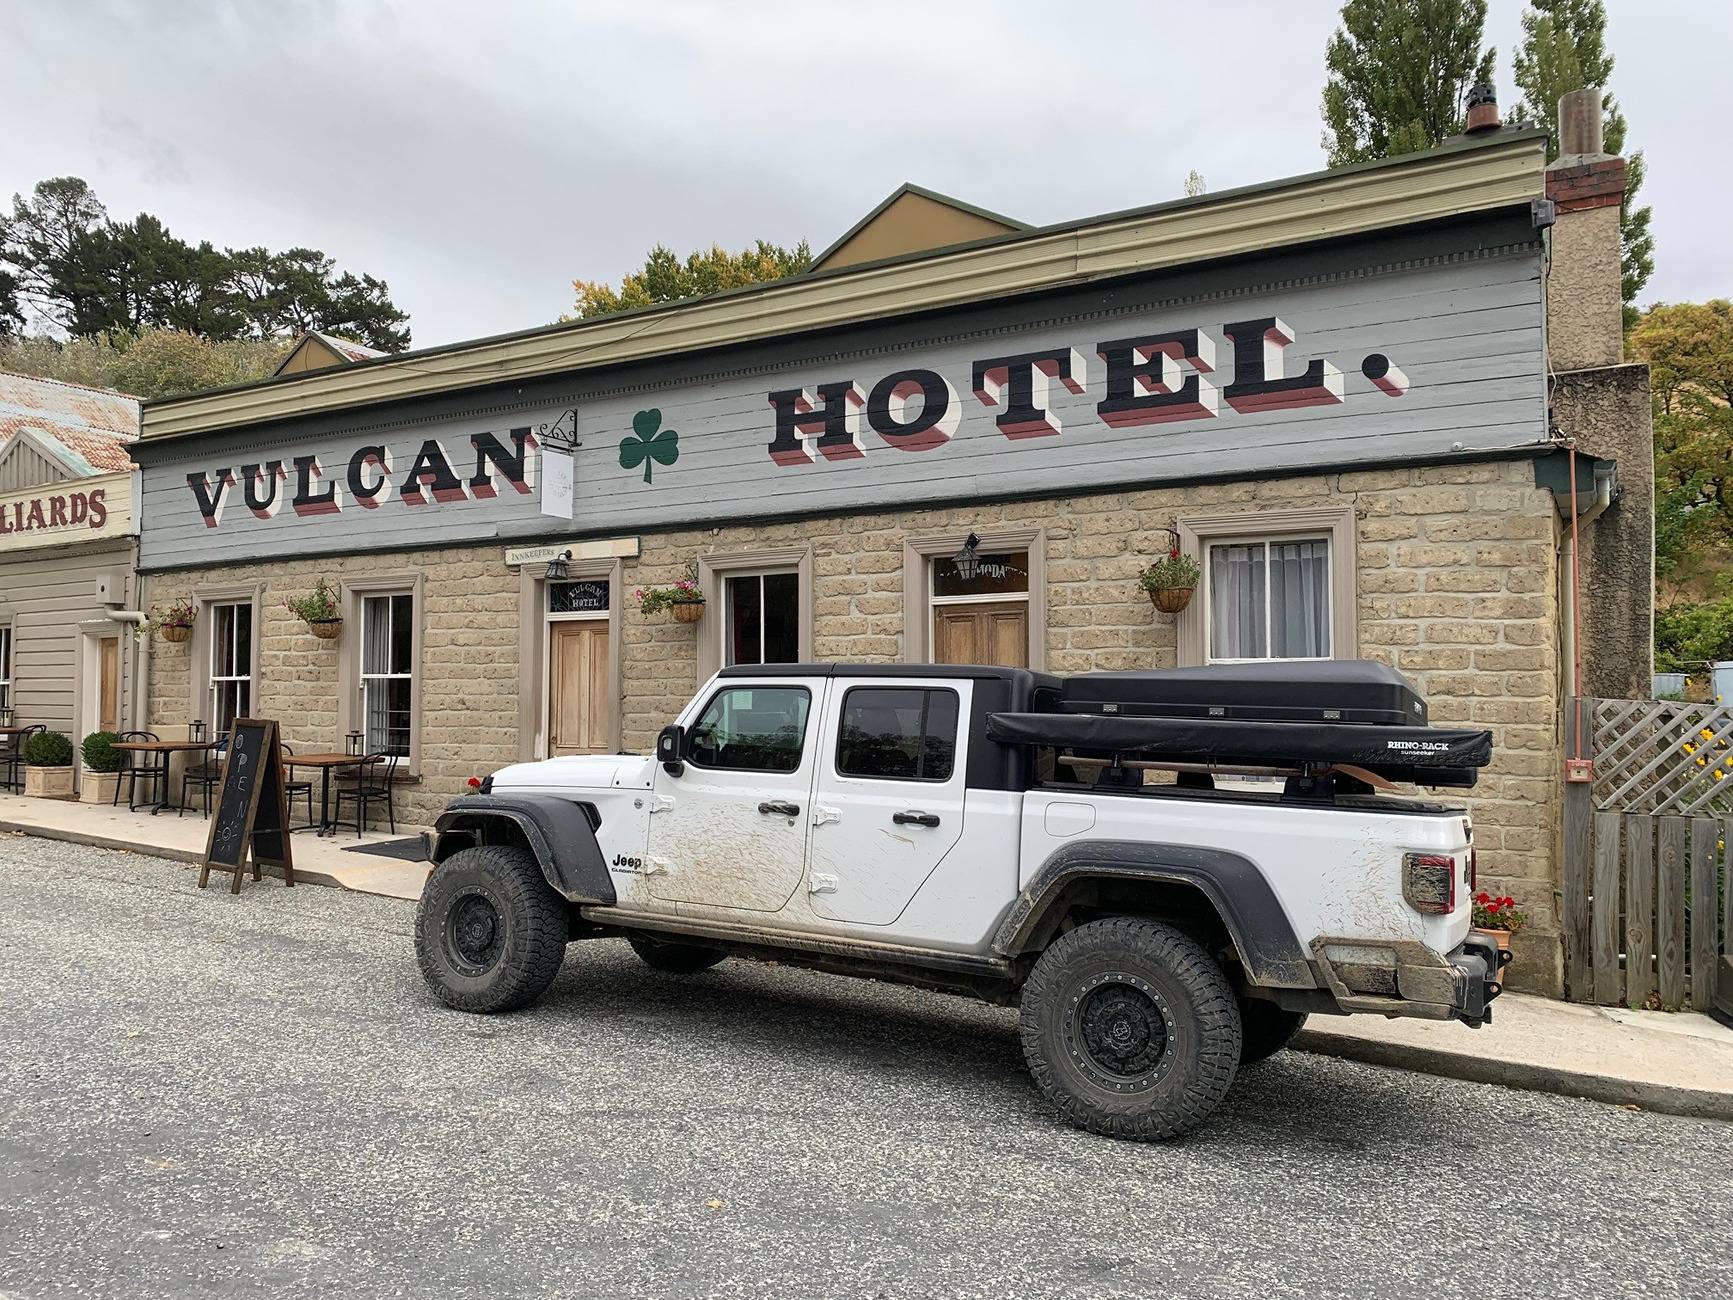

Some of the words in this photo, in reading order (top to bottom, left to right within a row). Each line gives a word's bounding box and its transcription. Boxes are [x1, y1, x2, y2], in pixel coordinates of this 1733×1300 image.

[186, 426, 541, 529] VULCAN
[569, 583, 602, 597] VULCAN
[572, 598, 599, 608] HOTEL
[1387, 741, 1449, 750] RHINO-RACK
[235, 734, 249, 818] OPEN
[613, 854, 641, 869] Jeep
